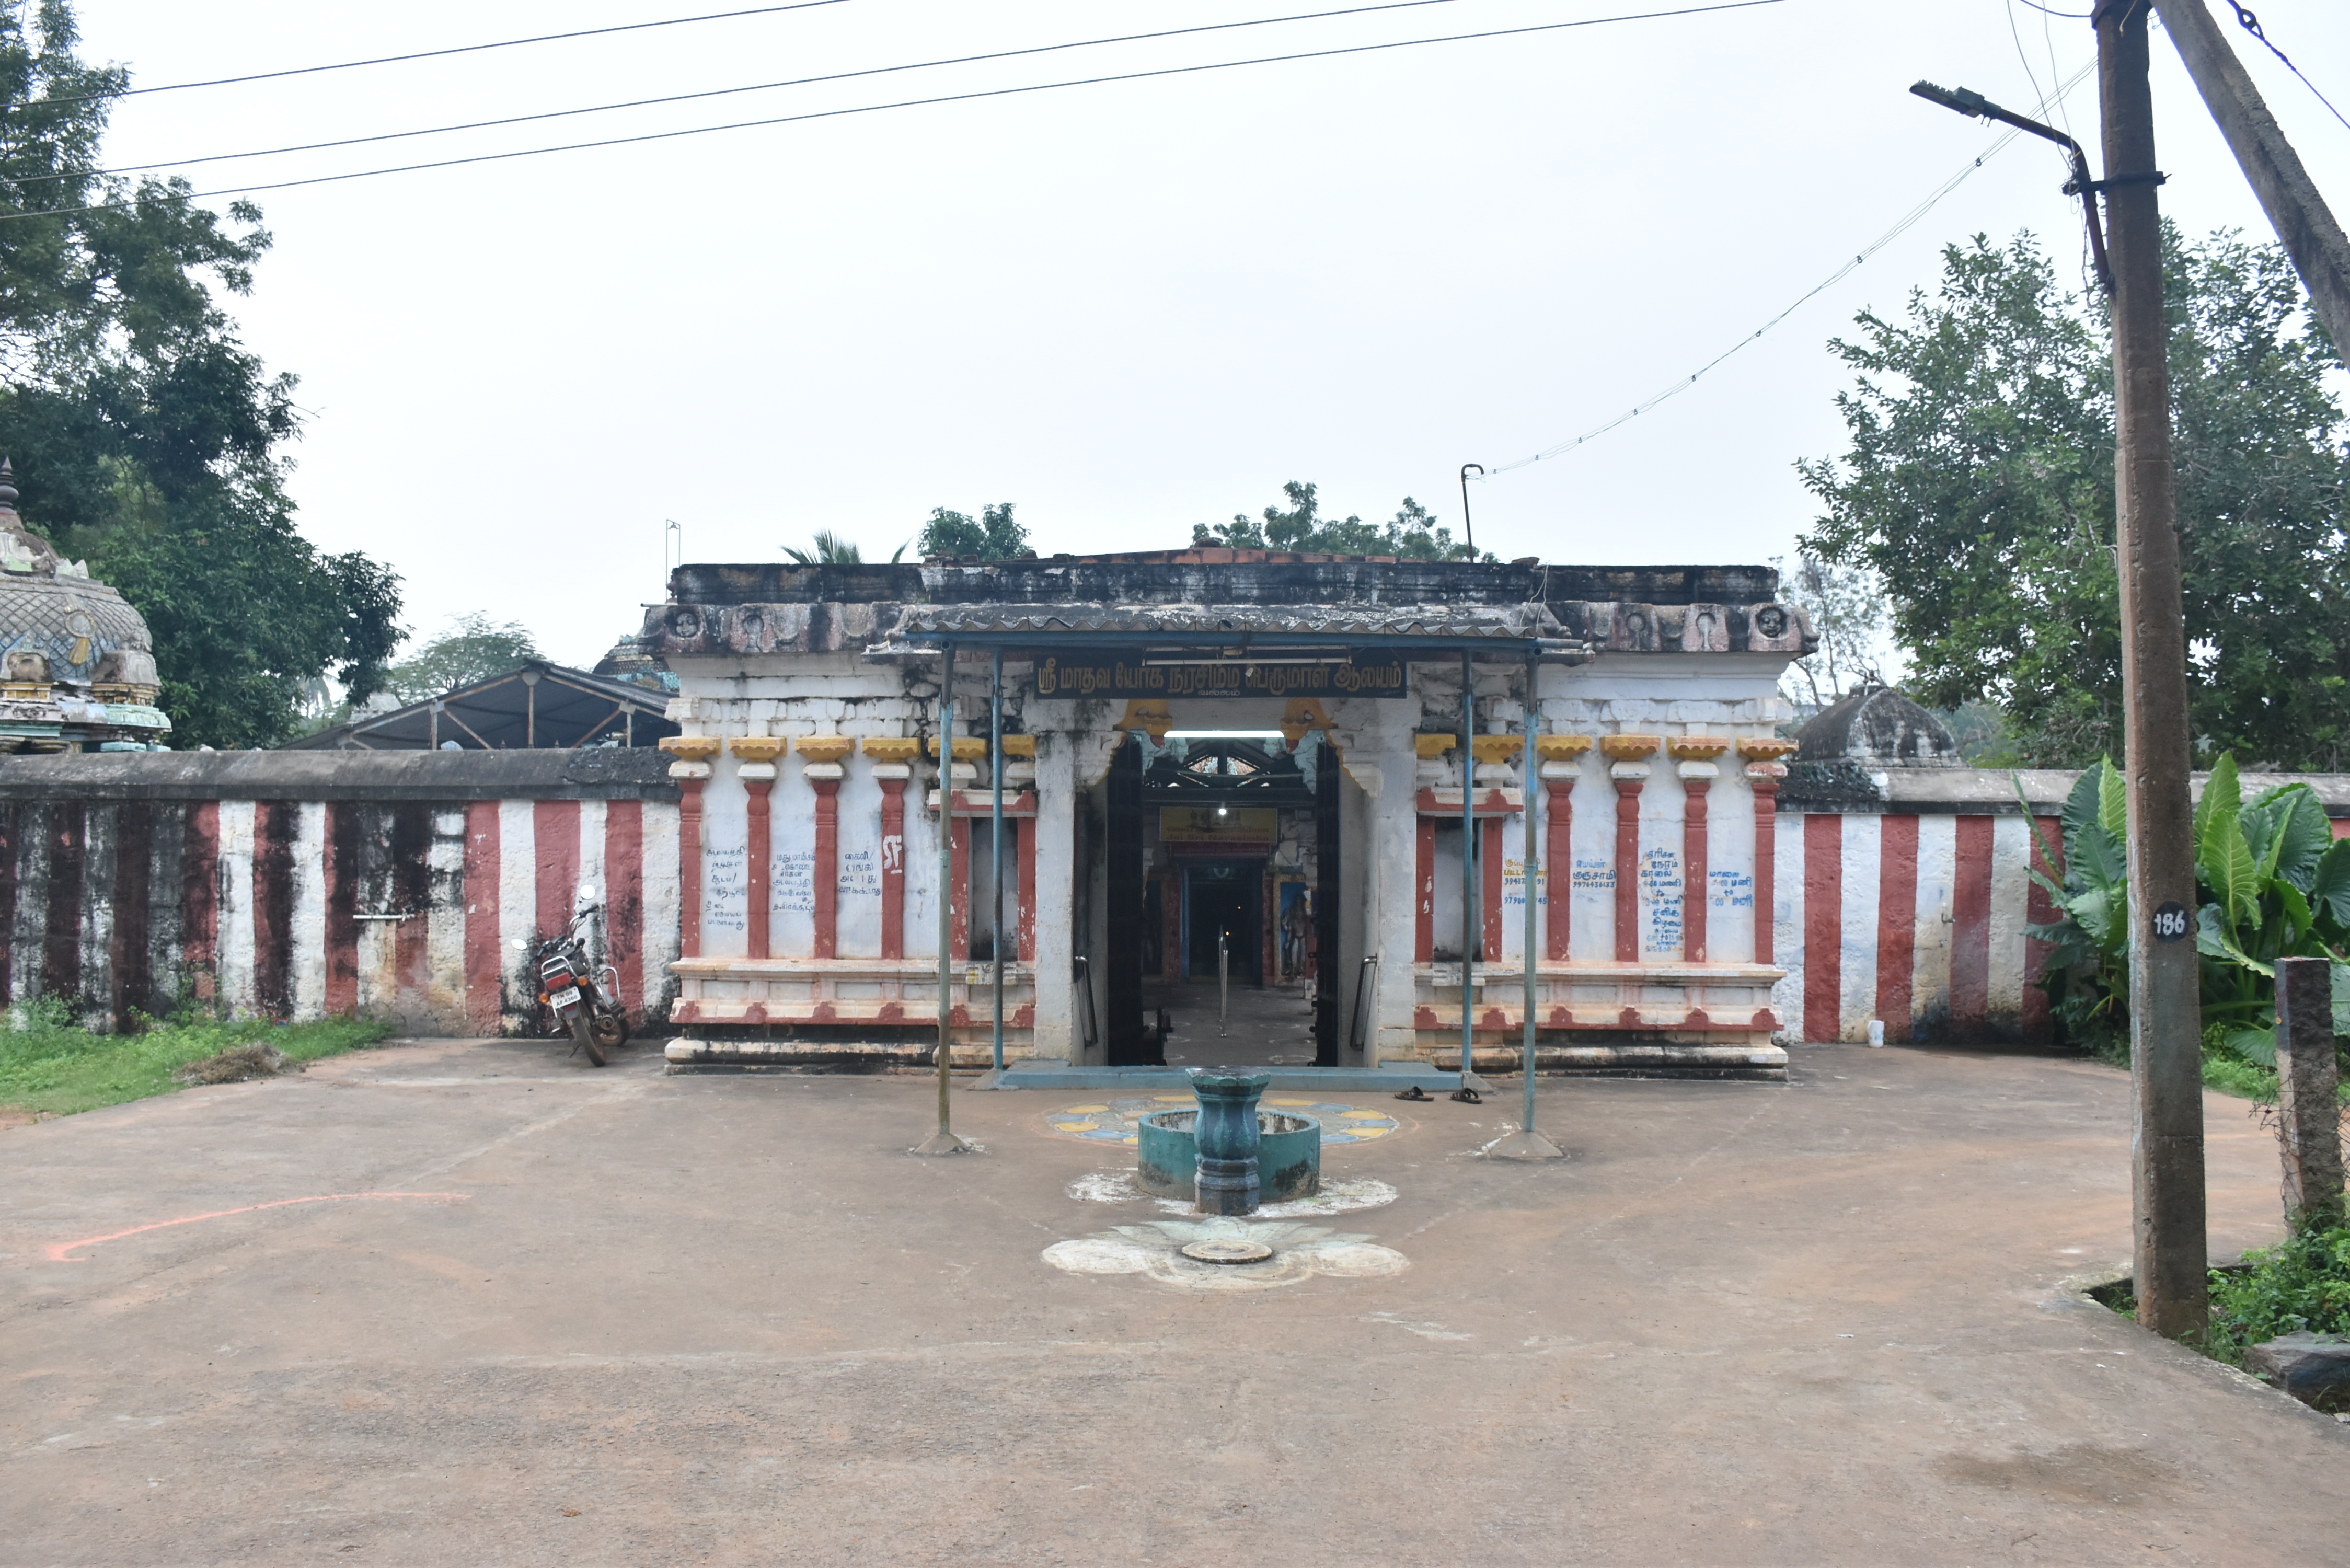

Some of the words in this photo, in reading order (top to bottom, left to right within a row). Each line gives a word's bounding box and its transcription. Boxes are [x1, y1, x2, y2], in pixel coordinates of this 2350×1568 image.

[1061, 666, 1110, 694] மாதவ
[1115, 661, 1164, 689] யோக
[1168, 663, 1240, 695] நரசிம்ம
[1246, 662, 1330, 696] பெருமாள்
[1334, 660, 1402, 693] ஆலயம்
[1573, 870, 1617, 881] குருசாமி
[2153, 910, 2185, 936] 186
